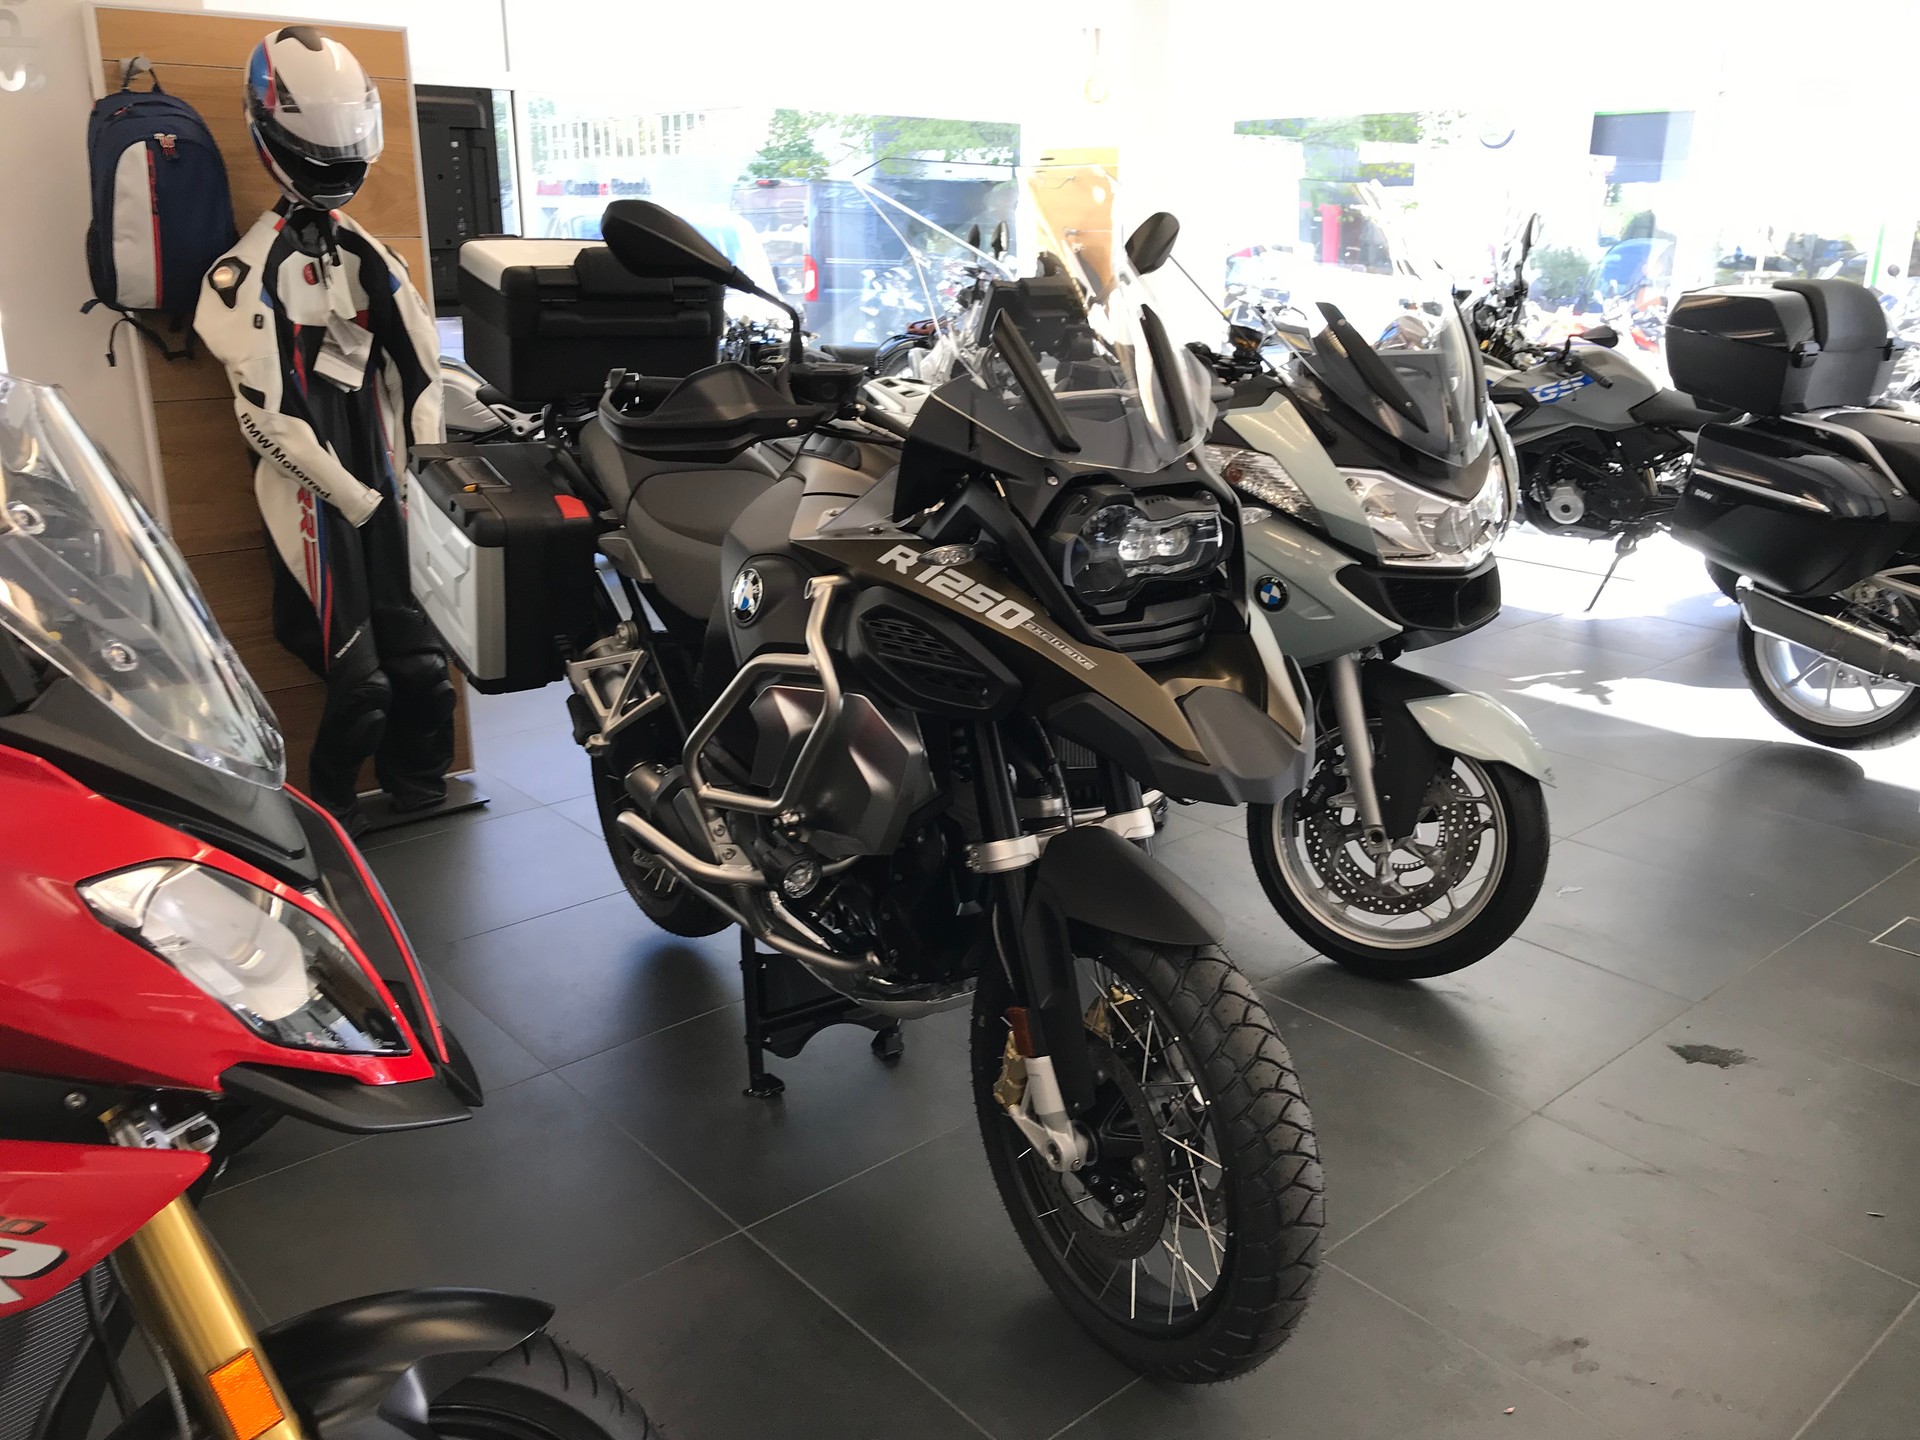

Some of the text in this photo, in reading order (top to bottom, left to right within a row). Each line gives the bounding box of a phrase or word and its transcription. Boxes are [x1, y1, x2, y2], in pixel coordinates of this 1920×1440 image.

[241, 412, 331, 499] BMW Motorrad
[876, 544, 1035, 630] R 1250
[1024, 622, 1096, 671] exclusive
